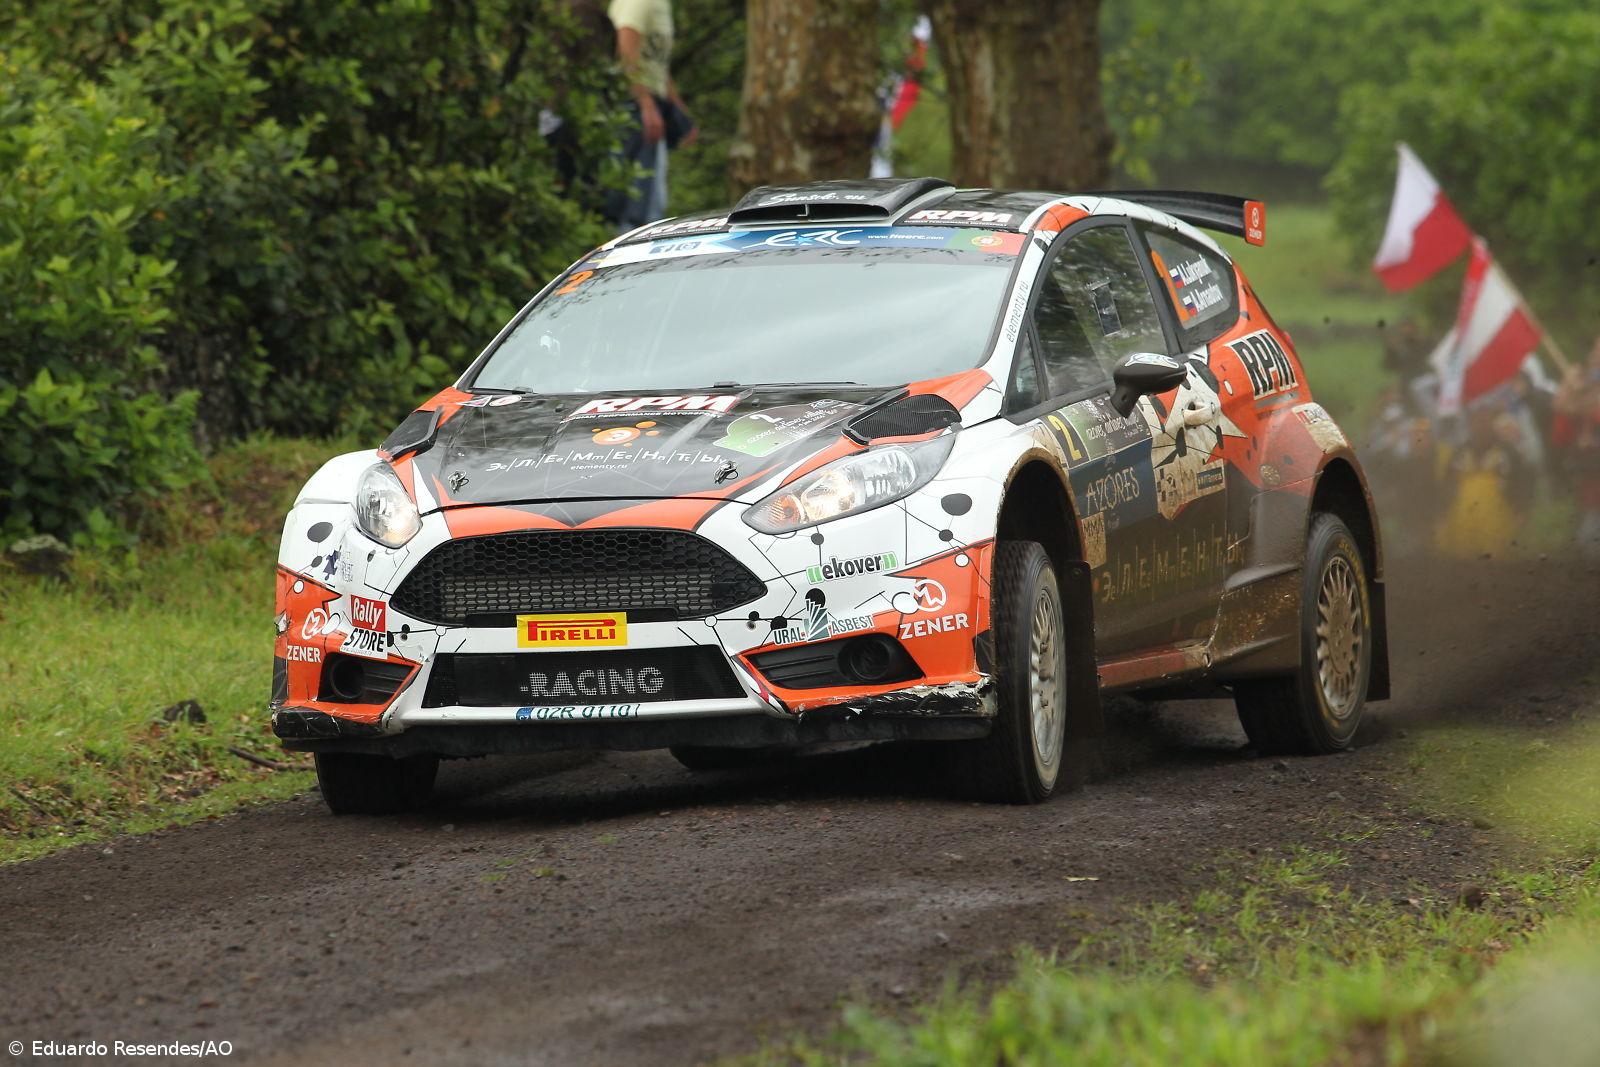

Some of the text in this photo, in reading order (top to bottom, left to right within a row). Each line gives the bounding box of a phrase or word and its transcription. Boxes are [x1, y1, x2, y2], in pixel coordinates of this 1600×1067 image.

[908, 209, 1013, 224] RPM
[1006, 280, 1030, 343] elementy.ru
[1228, 331, 1297, 398] RPM
[566, 394, 739, 418] RPM
[1047, 415, 1082, 460] 2
[570, 463, 629, 471] elementy.ru
[1085, 466, 1140, 517] AZORES
[821, 553, 884, 580] ekover
[353, 597, 383, 629] Rally
[831, 614, 874, 634] ASBEST
[527, 618, 617, 641] PIRELLI
[773, 626, 804, 645] URAL
[900, 613, 970, 640] ZENER
[343, 628, 386, 653] STORE
[286, 645, 322, 663] ZENER
